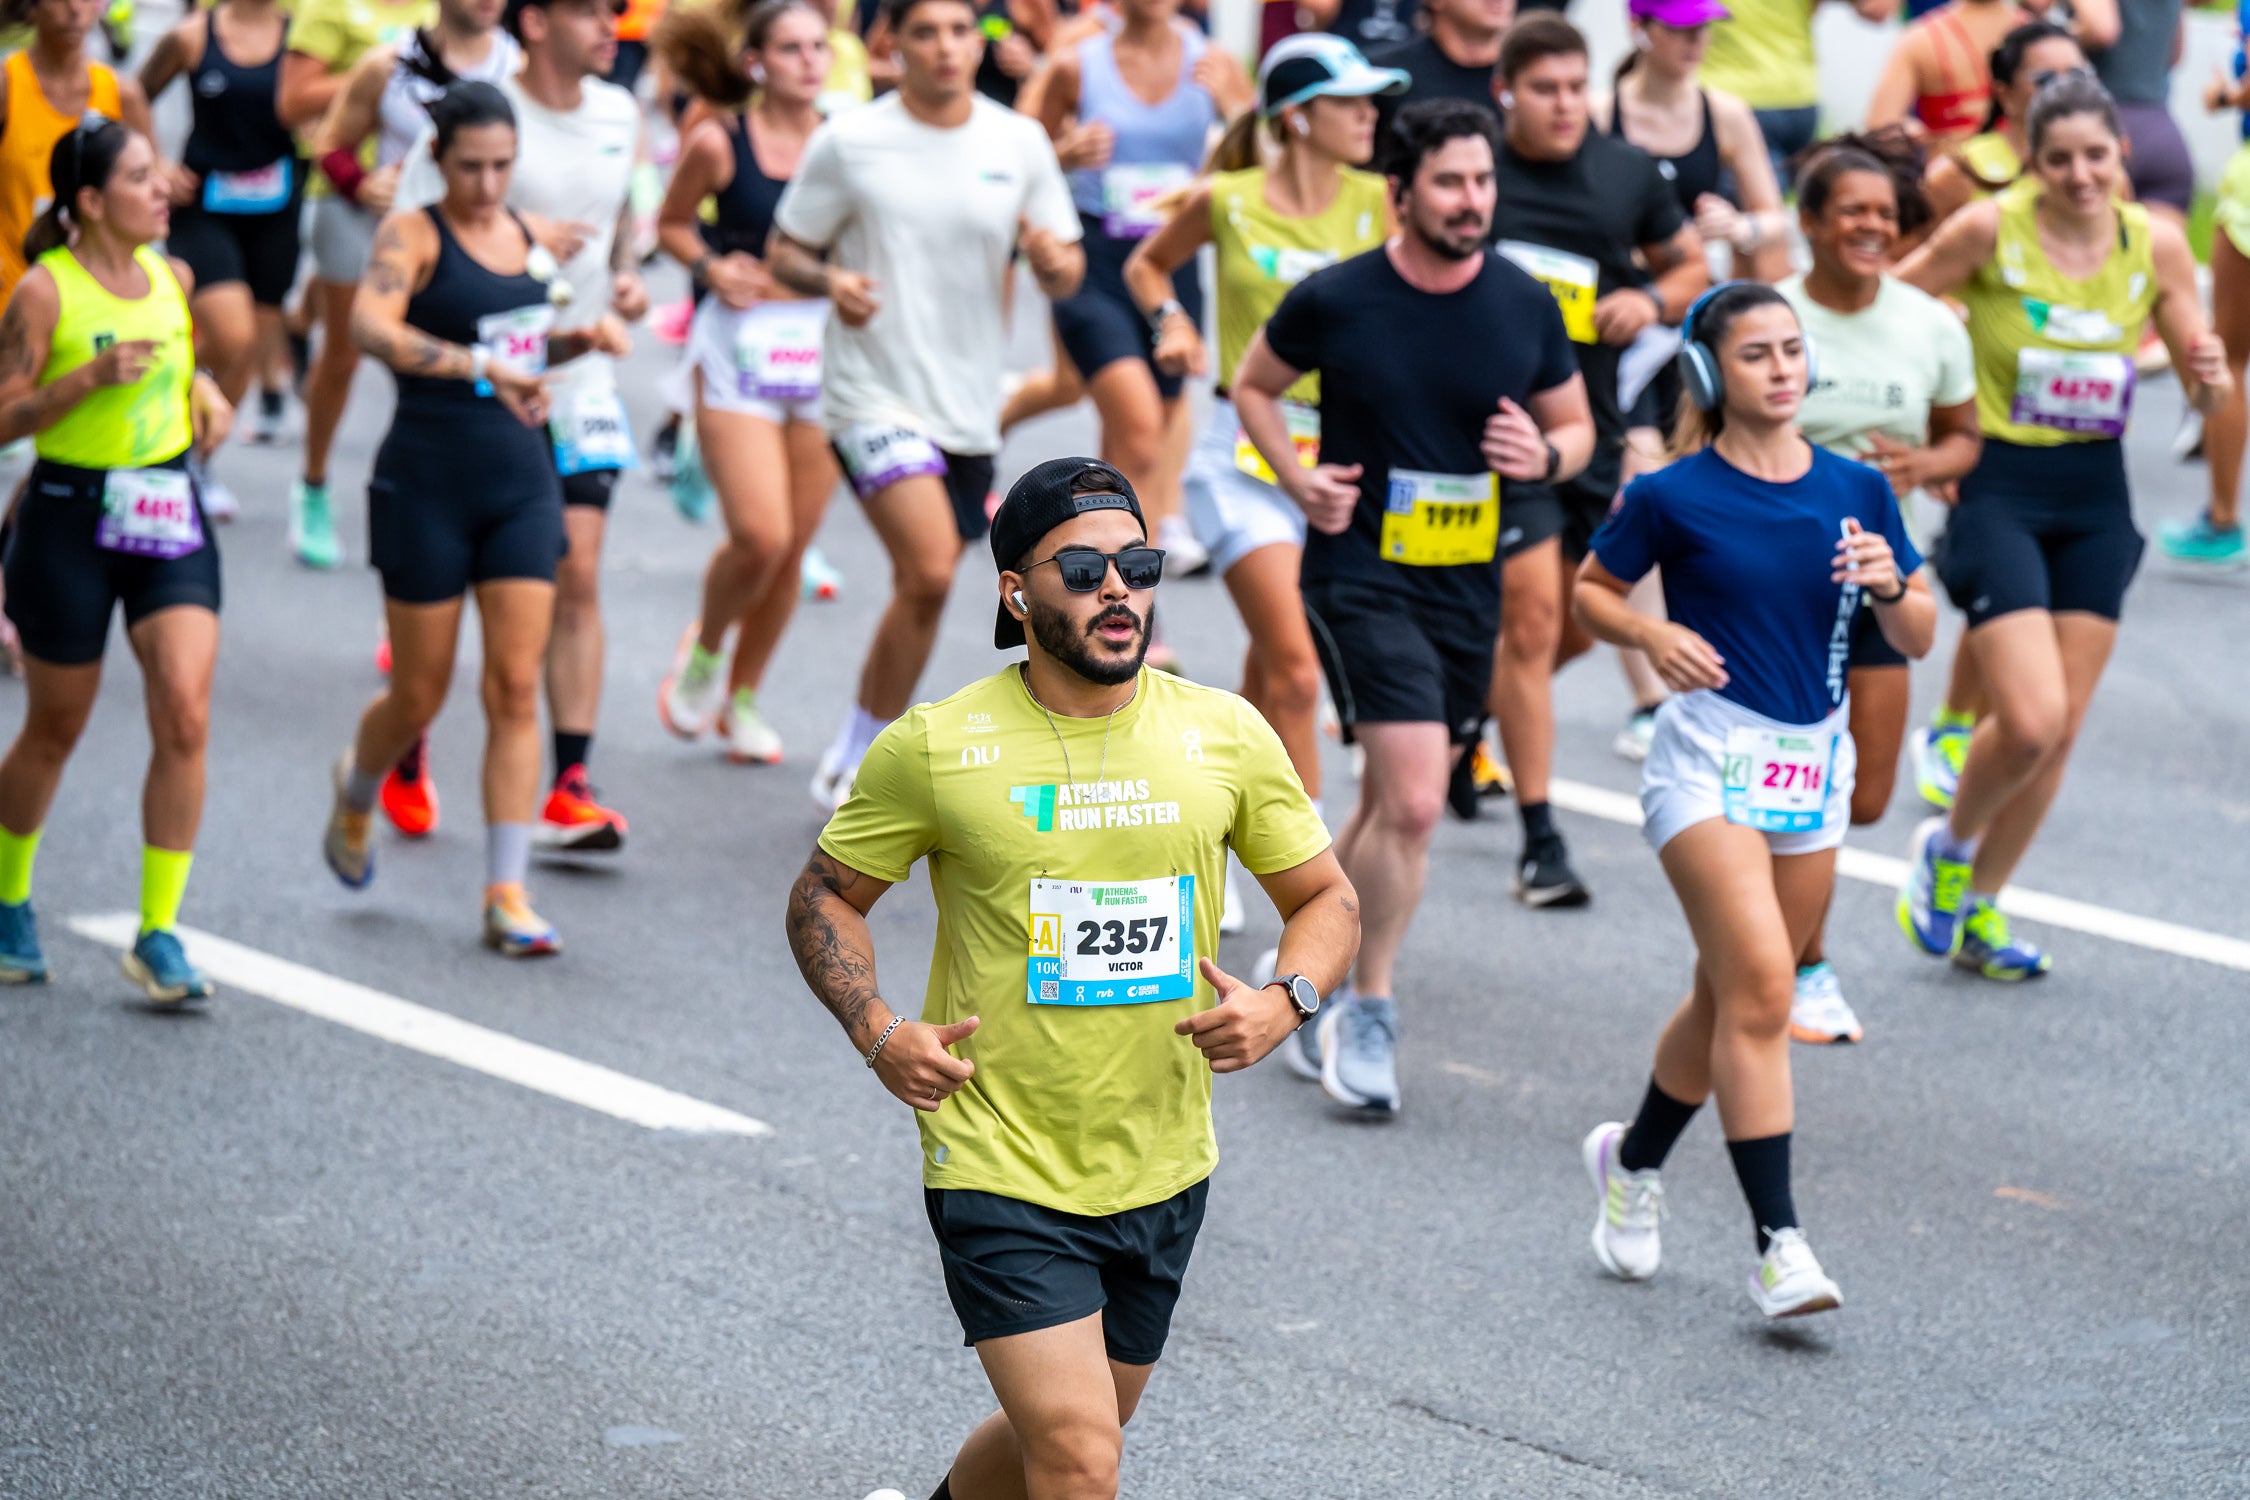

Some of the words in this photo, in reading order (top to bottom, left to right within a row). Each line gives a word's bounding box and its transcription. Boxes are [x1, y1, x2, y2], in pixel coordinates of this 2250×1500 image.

[1058, 779, 1150, 806] ATHENAS
[1059, 807, 1102, 831] RUN
[1104, 802, 1181, 828] FASTER
[1104, 886, 1138, 897] ATHENAS
[1105, 896, 1120, 906] RUN
[1121, 895, 1148, 905] FASTER
[1037, 920, 1054, 951] A
[1076, 916, 1168, 956] 2357
[1035, 962, 1060, 975] 10K
[1108, 961, 1144, 972] VICTOR
